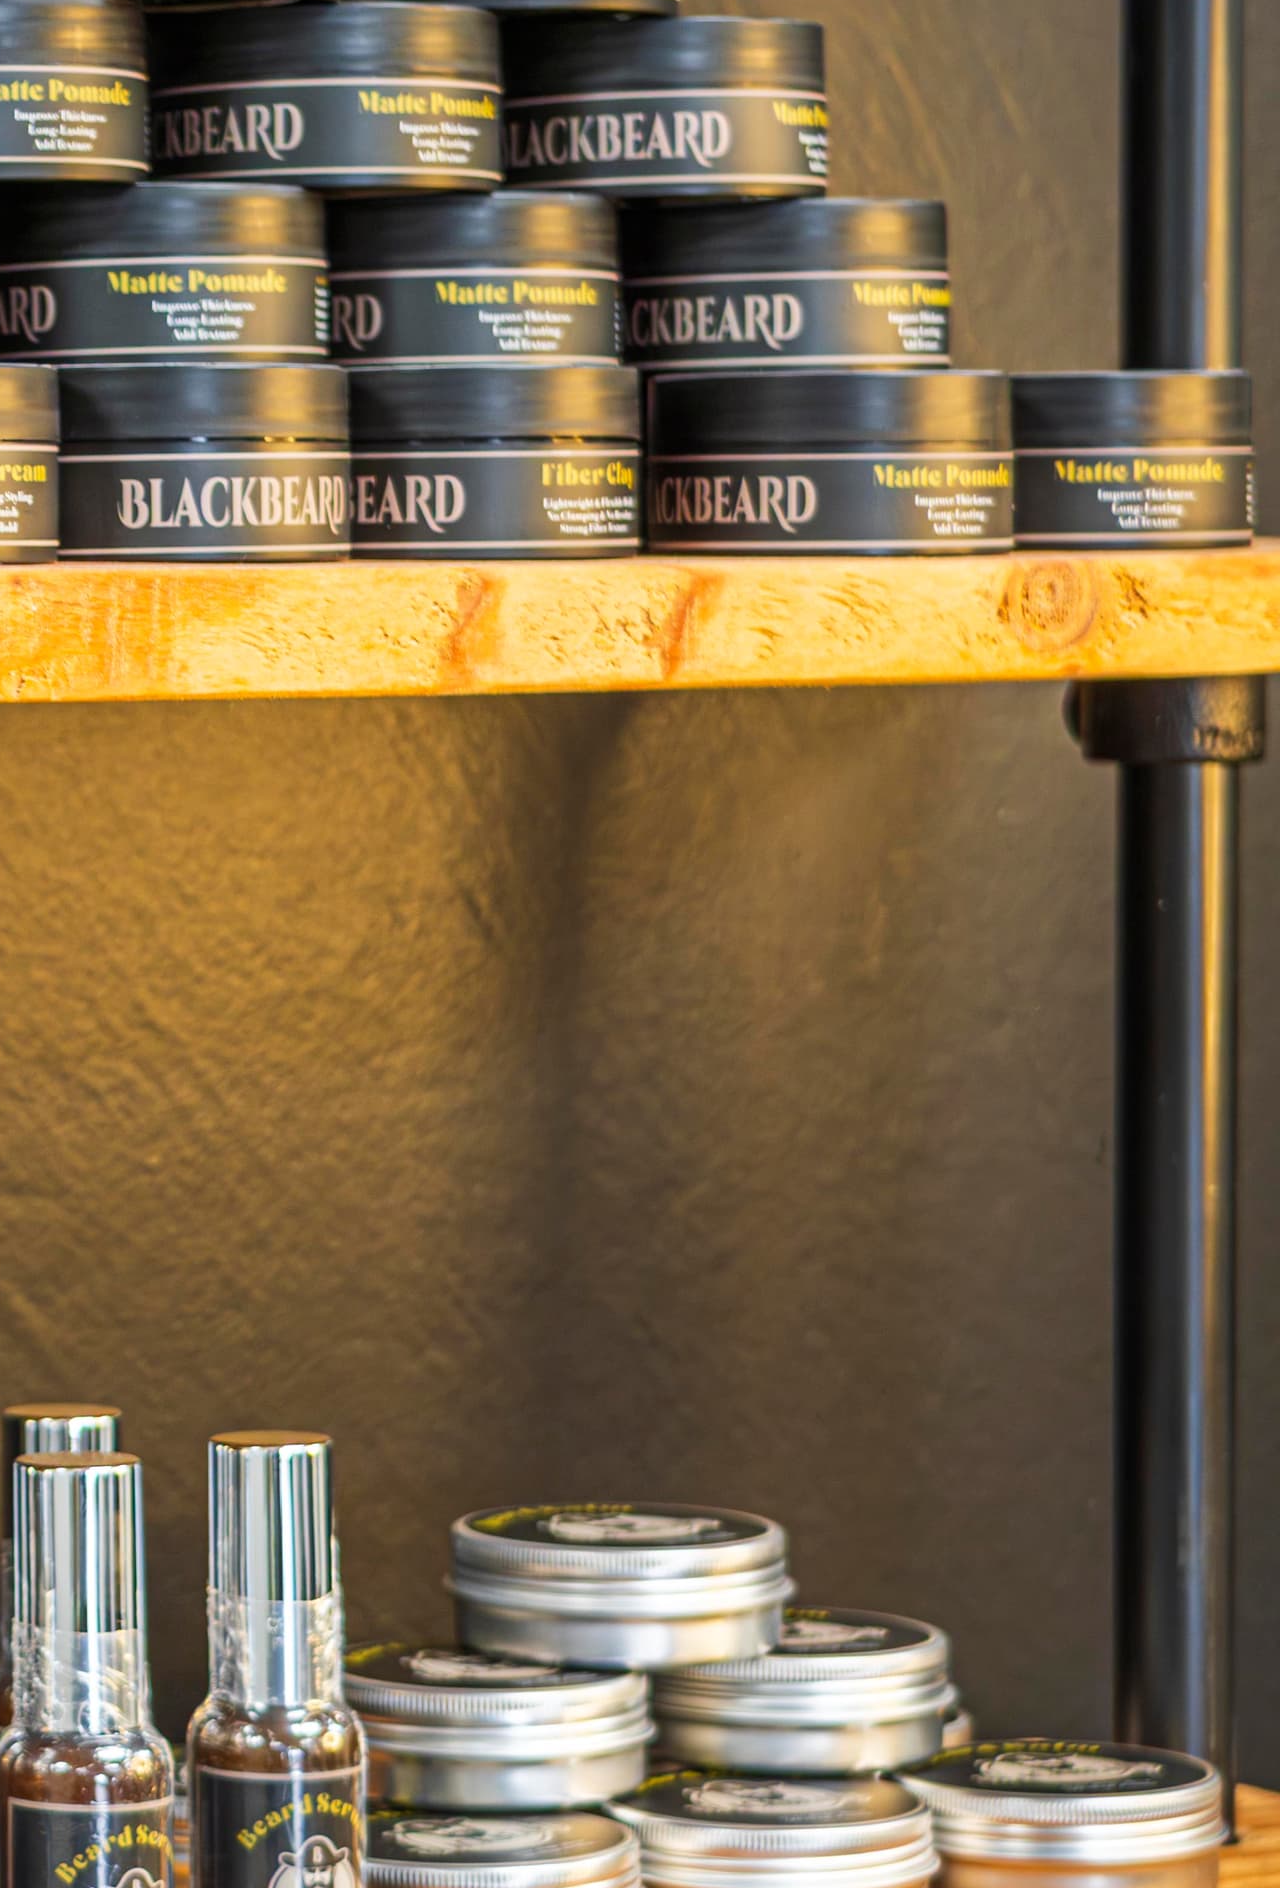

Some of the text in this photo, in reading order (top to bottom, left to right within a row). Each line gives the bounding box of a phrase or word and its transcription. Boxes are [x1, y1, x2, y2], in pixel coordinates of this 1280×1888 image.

[107, 269, 287, 295] Matte Pomade
[436, 279, 598, 306] Matte Pomade
[873, 464, 941, 489] Matte
[1054, 457, 1224, 483] Matte Pomade
[117, 476, 345, 535] BLACKBEARD
[54, 1825, 132, 1885] Beard
